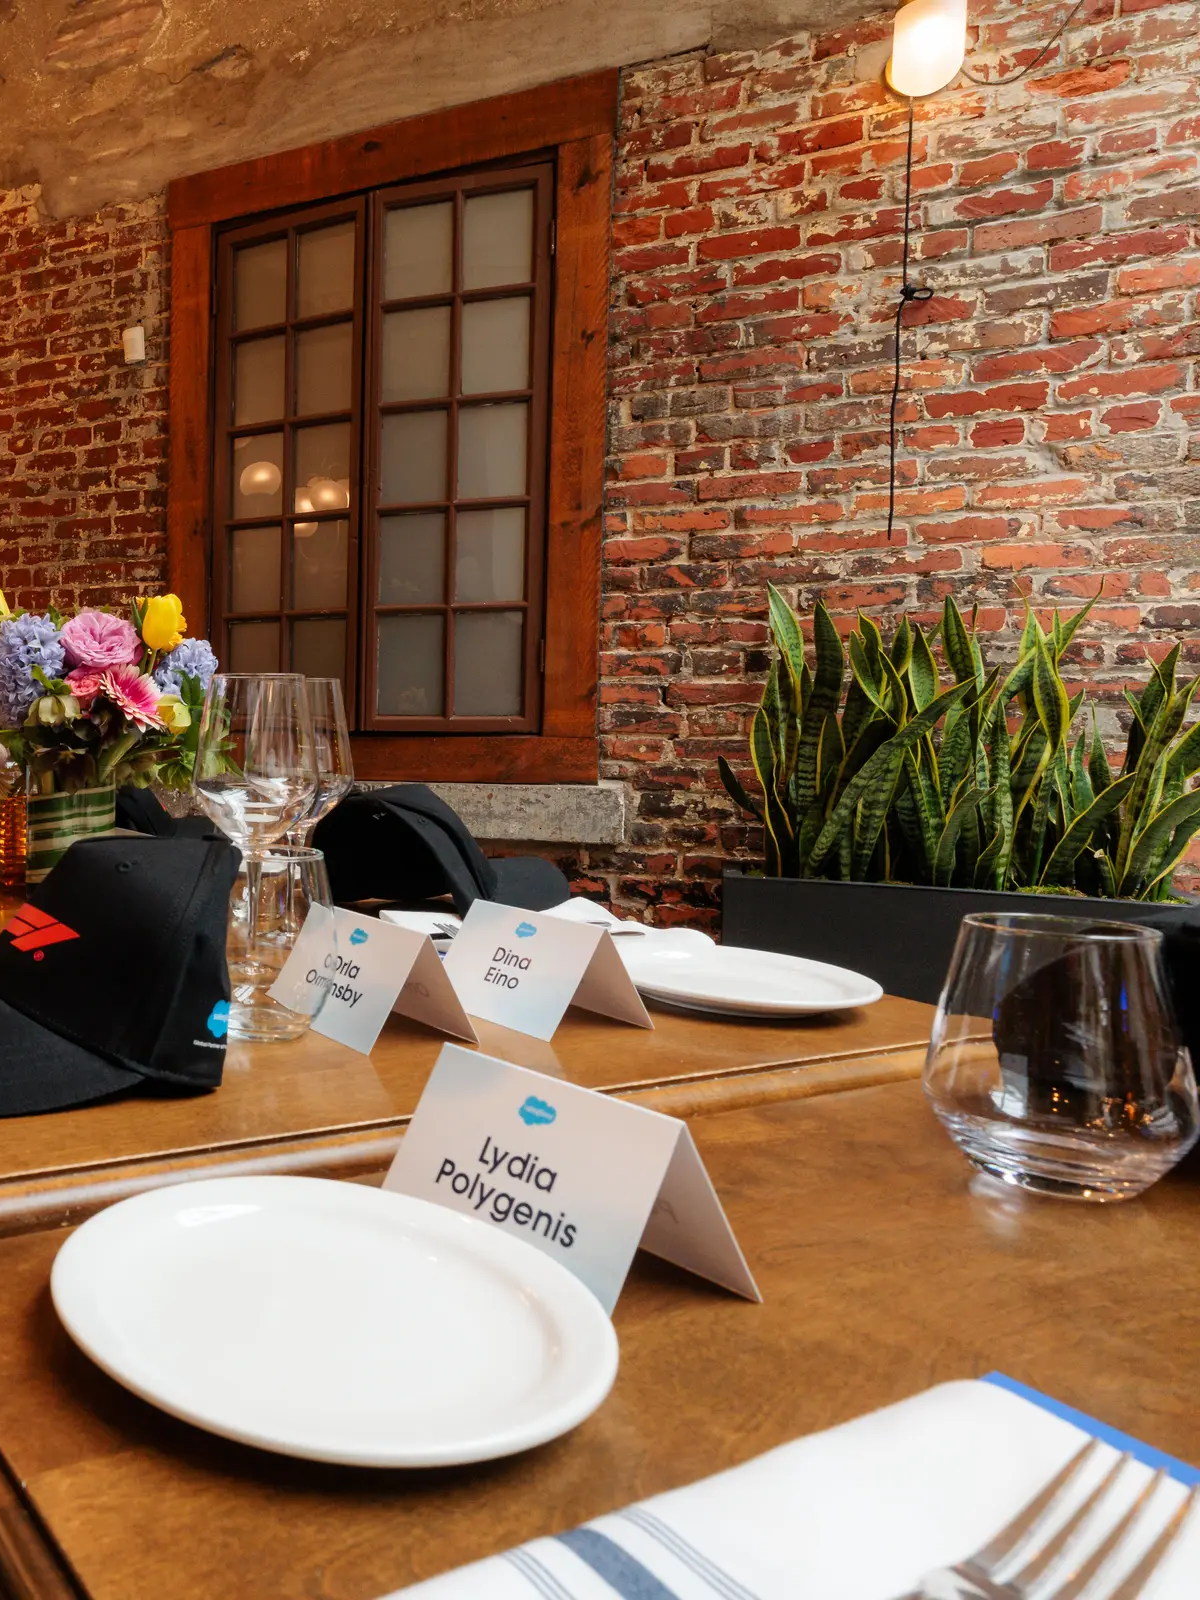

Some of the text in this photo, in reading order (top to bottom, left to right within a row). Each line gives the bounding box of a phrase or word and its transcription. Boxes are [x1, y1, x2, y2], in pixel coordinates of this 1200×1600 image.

[483, 966, 519, 990] Eino
[491, 946, 532, 971] Dina
[477, 1136, 558, 1193] Lydia
[434, 1158, 578, 1249] Polygenis
